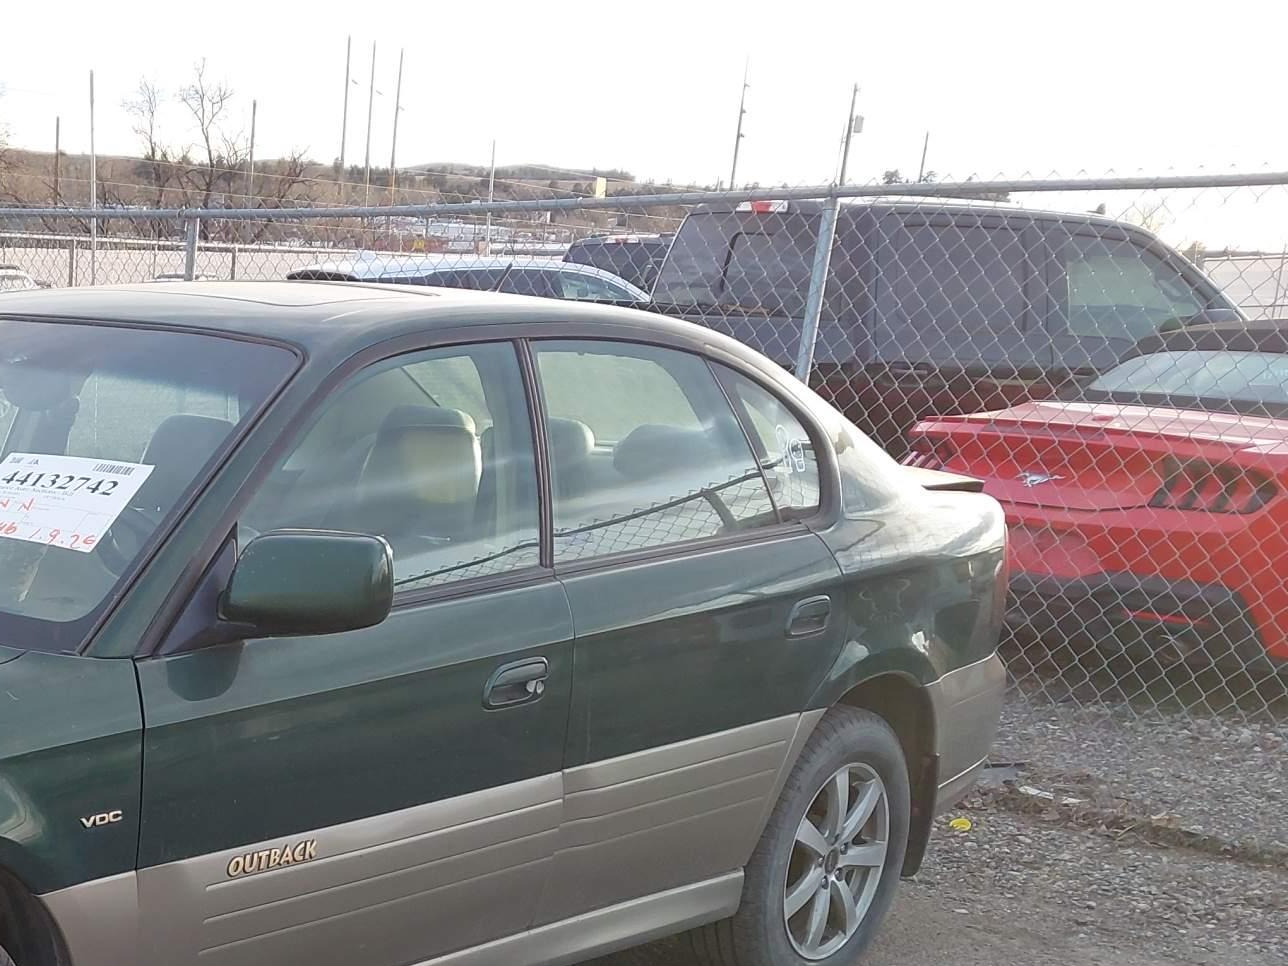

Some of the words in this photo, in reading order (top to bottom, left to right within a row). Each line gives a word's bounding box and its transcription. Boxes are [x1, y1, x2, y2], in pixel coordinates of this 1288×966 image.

[2, 470, 120, 497] 44132742
[80, 810, 123, 828] VDC
[227, 840, 318, 878] OUTBACK
